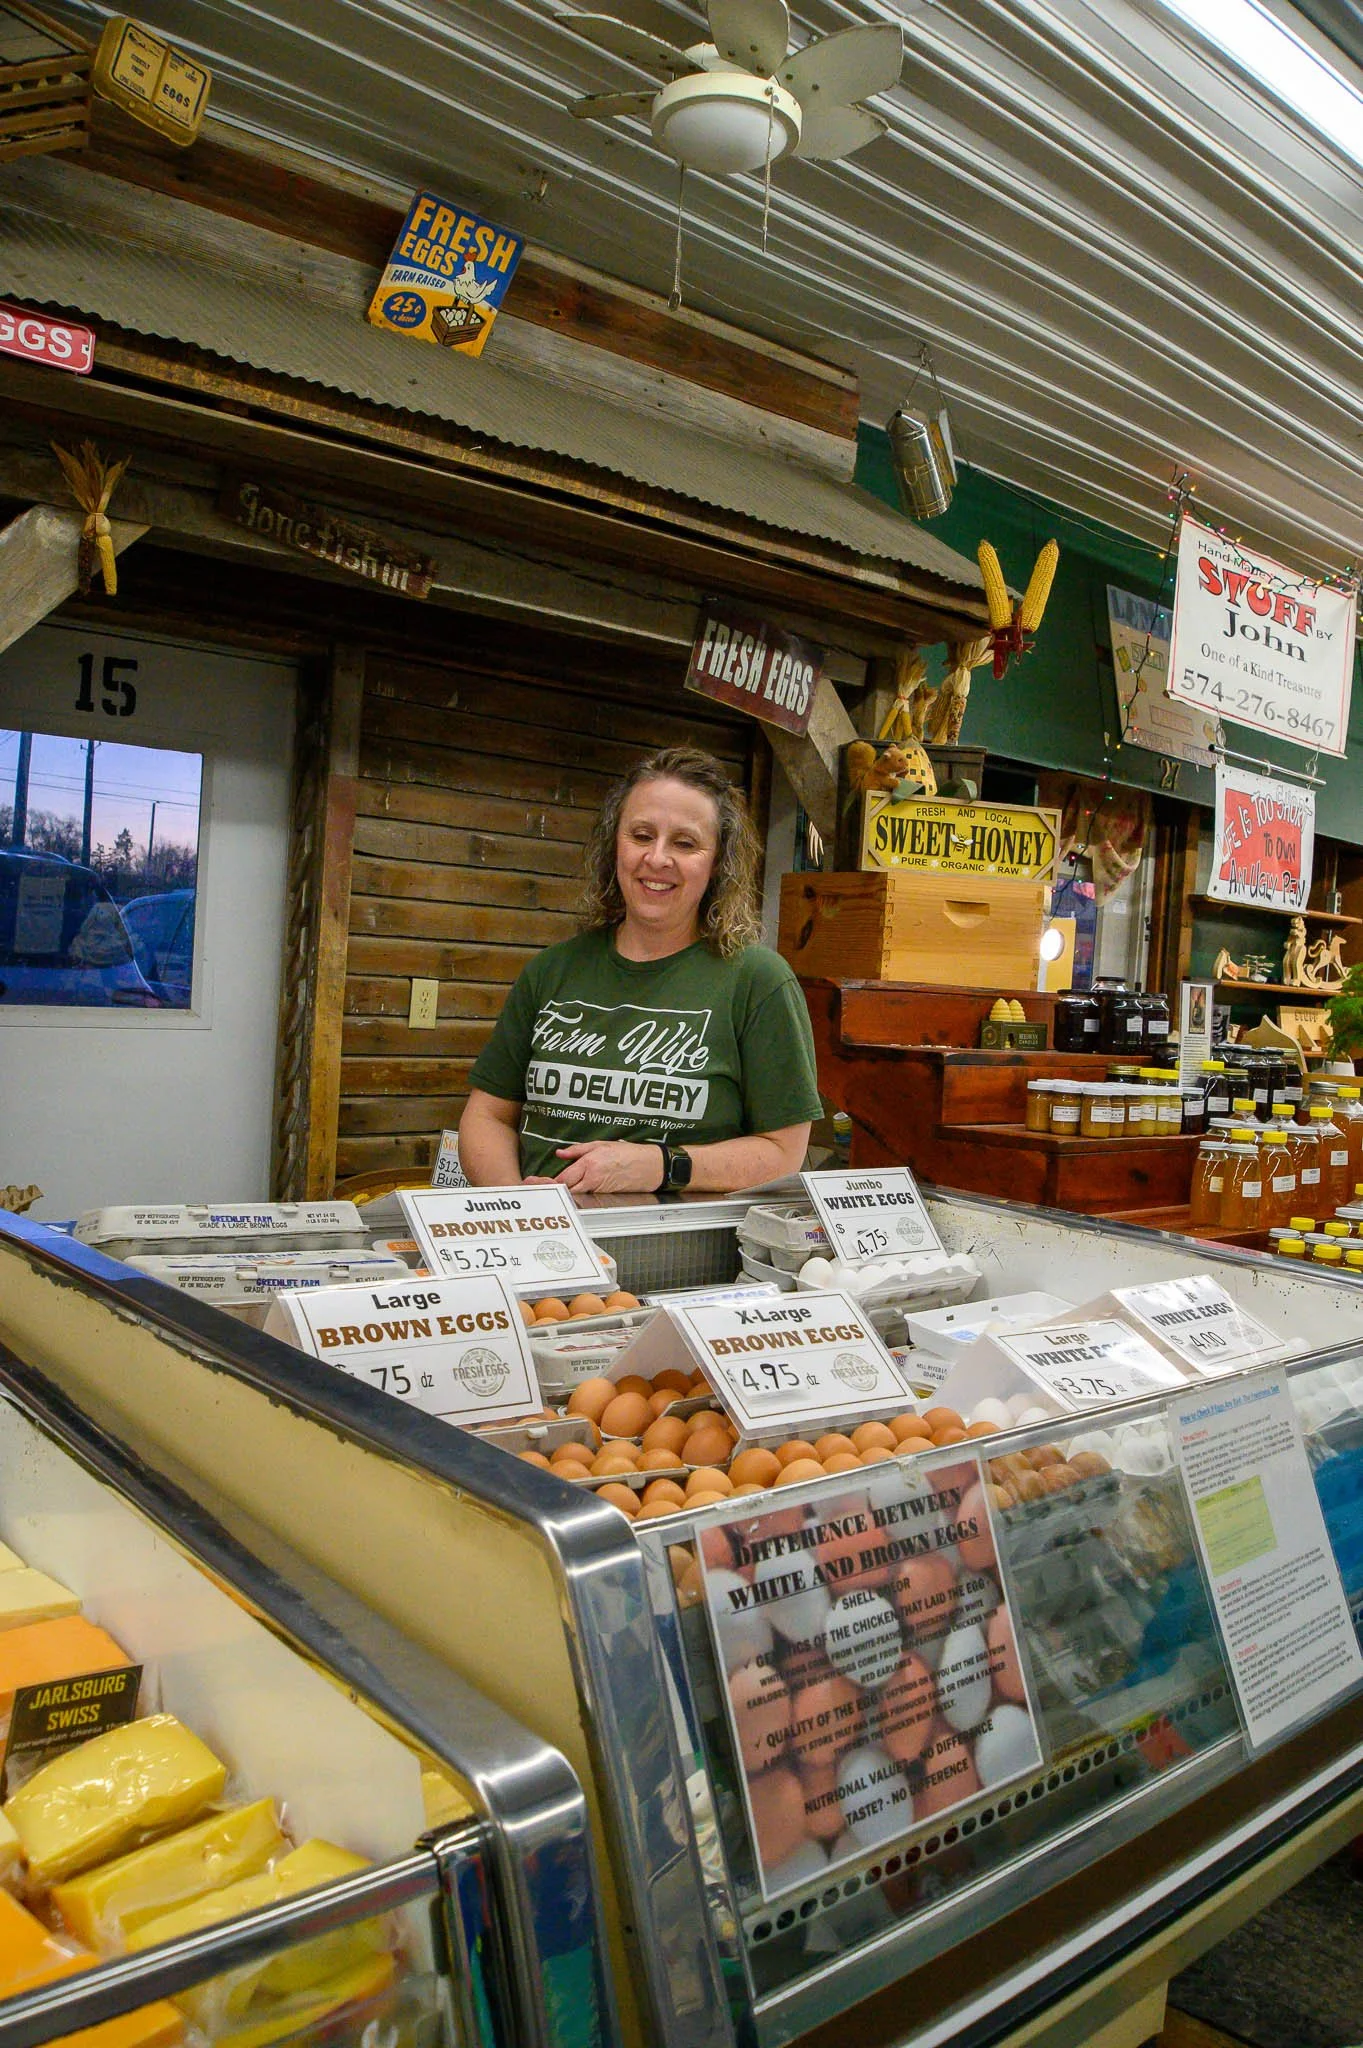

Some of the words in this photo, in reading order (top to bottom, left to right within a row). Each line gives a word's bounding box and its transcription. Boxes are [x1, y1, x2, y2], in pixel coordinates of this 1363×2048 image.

[162, 83, 191, 108] EGGS
[410, 198, 517, 273] FRESH
[399, 233, 458, 276] EGGS
[390, 269, 416, 284] FARM
[416, 274, 447, 289] RAISED
[1198, 556, 1317, 637] STUFF
[1316, 629, 1334, 641] BY
[1223, 606, 1308, 663] John
[697, 618, 768, 694] FRESH
[763, 648, 814, 716] EGGS
[1201, 642, 1225, 664] One
[1228, 653, 1241, 667] of
[1243, 663, 1249, 673] a
[1250, 660, 1274, 682] Kind
[74, 652, 138, 717] 15
[1180, 668, 1336, 741] 574-276-8467
[916, 807, 946, 817] FRESH
[957, 807, 976, 818] AND
[985, 811, 1013, 826] LOCAL
[1216, 821, 1242, 865] LIFE
[1238, 806, 1253, 840] IS
[1251, 791, 1275, 828] TOO
[1275, 785, 1313, 834] SHORT
[875, 814, 956, 858] SWEET
[968, 825, 1049, 867] HONEY
[1275, 838, 1296, 864] OWN
[901, 856, 928, 866] PURE
[941, 860, 985, 872] ORGANIC
[997, 865, 1019, 875] RAW
[1229, 859, 1247, 895] AN
[1250, 860, 1278, 901] UGLY
[1282, 871, 1306, 907] PEN
[531, 1009, 607, 1057] Farm
[618, 1020, 710, 1075] Wife
[568, 1071, 703, 1113] DELIVERY
[613, 1116, 636, 1127] FEED
[638, 1118, 658, 1127] THE
[438, 1158, 464, 1175] $12.
[845, 1178, 883, 1191] Jumbo
[464, 1198, 521, 1213] Jumbo
[823, 1194, 877, 1210] WHITE
[879, 1191, 915, 1206] EGGS
[210, 1215, 251, 1223] GREENLIFE
[253, 1215, 273, 1223] FARM
[428, 1219, 514, 1238] BROWN
[515, 1215, 571, 1232] EGGS
[857, 1228, 888, 1256] 4.75
[509, 1255, 521, 1267] dz
[243, 1286, 265, 1294] GRADE
[266, 1286, 272, 1294] A
[256, 1278, 298, 1287] GREENLIFE
[300, 1279, 320, 1287] FARM
[371, 1290, 441, 1310] Large
[735, 1306, 812, 1325] X-Large
[1151, 1309, 1202, 1327] WHITE
[1197, 1302, 1234, 1318] EGGS
[317, 1318, 432, 1348] BROWN
[437, 1311, 510, 1336] EGGS
[708, 1330, 803, 1356] BROWN
[806, 1323, 866, 1345] EGGS
[1044, 1332, 1091, 1346] Large
[1026, 1345, 1095, 1367] WHITE
[420, 1371, 435, 1388] dz
[453, 1364, 485, 1381] FRESH
[485, 1362, 511, 1376] EGGS
[806, 1374, 820, 1387] dz
[830, 1367, 856, 1380] FRESH
[855, 1364, 880, 1376] EGGS
[733, 1512, 871, 1567] DIFFERENCE
[870, 1486, 963, 1529] BETWEEN
[727, 1570, 806, 1611] WHITE
[809, 1553, 858, 1586] AND
[858, 1531, 931, 1571] BROWN
[933, 1516, 979, 1547] EGGS
[841, 1587, 875, 1610] SHELL
[813, 1633, 826, 1648] OF
[830, 1624, 851, 1642] THE
[852, 1609, 896, 1635] CHICKEN
[899, 1599, 923, 1618] THAT
[924, 1591, 946, 1608] LAID
[947, 1584, 964, 1600] THE
[965, 1577, 985, 1593] EGG
[857, 1653, 879, 1667] COME
[860, 1670, 875, 1683] RED
[945, 1682, 955, 1692] OR
[956, 1674, 974, 1688] FROM
[29, 1674, 127, 1710] JARLSBURG
[765, 1716, 815, 1749] QUALITY
[816, 1710, 831, 1727] OF
[833, 1701, 854, 1721] THE
[936, 1666, 950, 1678] YOU
[950, 1661, 962, 1672] GET
[962, 1656, 975, 1667] THE
[47, 1704, 101, 1731] SWISS
[803, 1774, 868, 1816] NUTRIONAL
[919, 1745, 935, 1762] NO
[935, 1718, 993, 1755] DIFFERENCE
[845, 1797, 884, 1826] TASTE?
[892, 1786, 907, 1804] NO
[908, 1757, 969, 1796] DIFFERENCE
